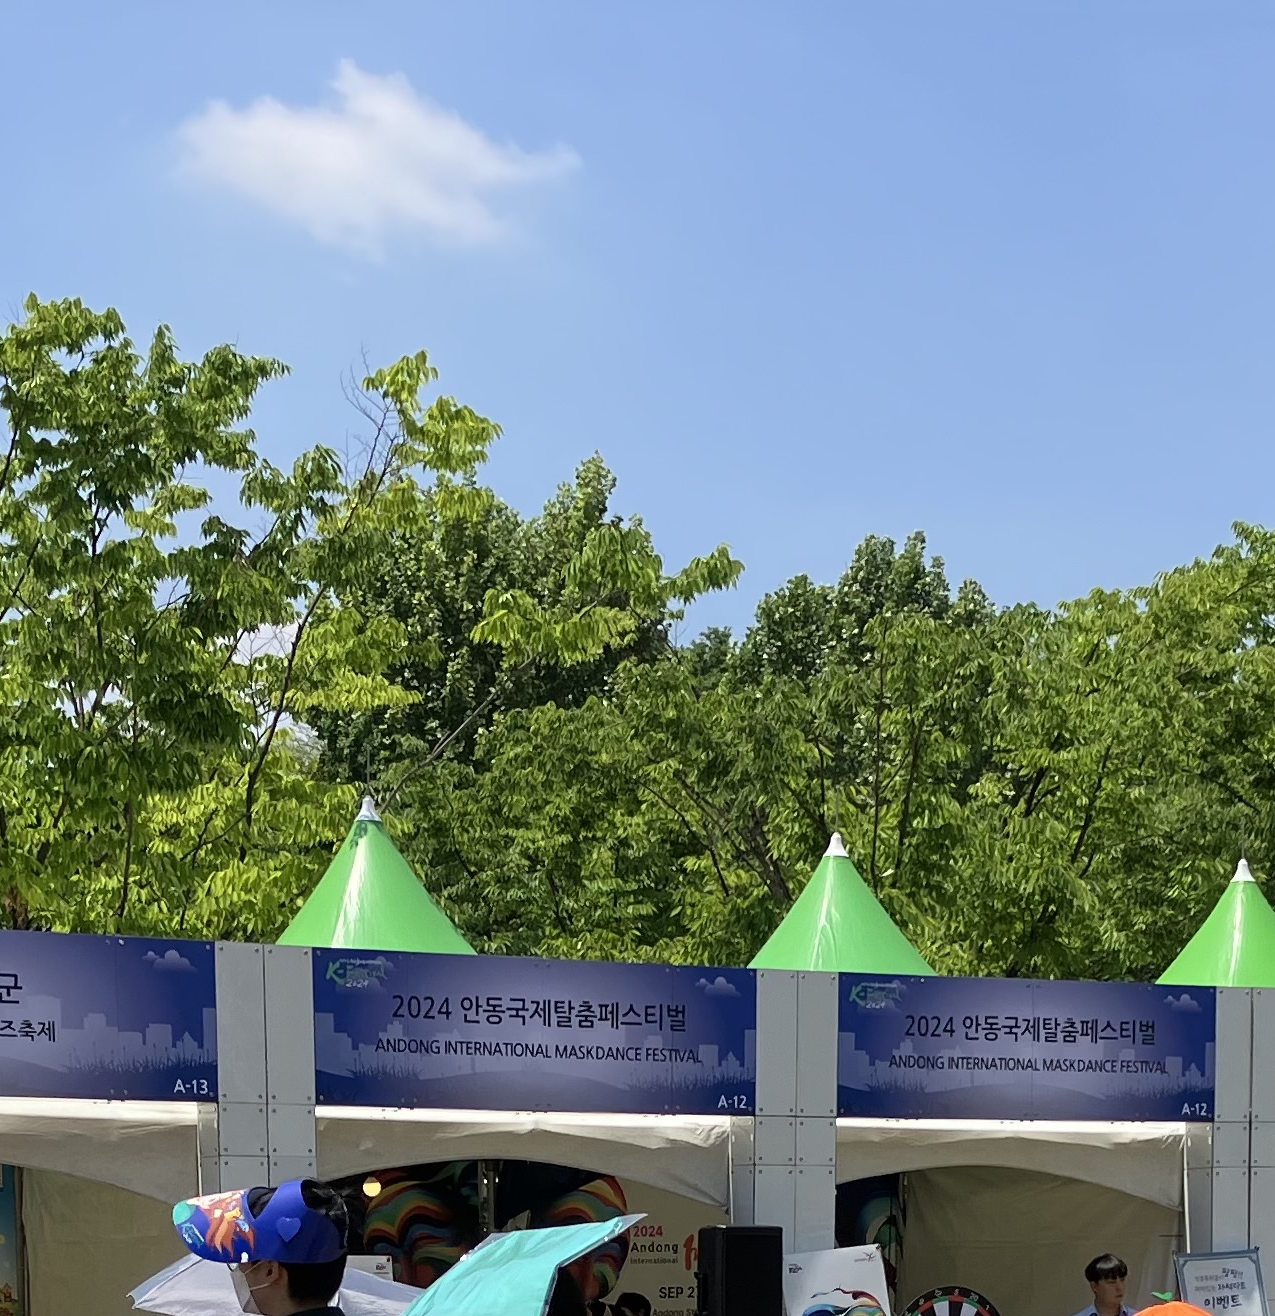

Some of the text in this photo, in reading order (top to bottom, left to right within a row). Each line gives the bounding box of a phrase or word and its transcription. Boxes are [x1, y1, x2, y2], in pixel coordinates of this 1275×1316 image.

[391, 994, 687, 1032] 2024 안동국제탈춤페스티벌
[904, 1014, 1156, 1046] 2024 안동국제탈춤페스티벌
[375, 1037, 441, 1055] ANDONG
[444, 1040, 552, 1060] INTERNATIONAL
[645, 1047, 704, 1065] FESTIVAL
[889, 1054, 945, 1070] ANDONG
[948, 1056, 1040, 1072] INTERNATIONAL
[1119, 1059, 1169, 1075] FESTIVAL
[174, 1078, 209, 1095] A-13
[717, 1094, 747, 1109] A-12
[1181, 1102, 1207, 1116] A-12
[632, 1225, 664, 1238] 2024
[630, 1241, 679, 1255] Andong
[658, 1286, 698, 1299] SEP 2
[1204, 1293, 1243, 1310] 이벤트
